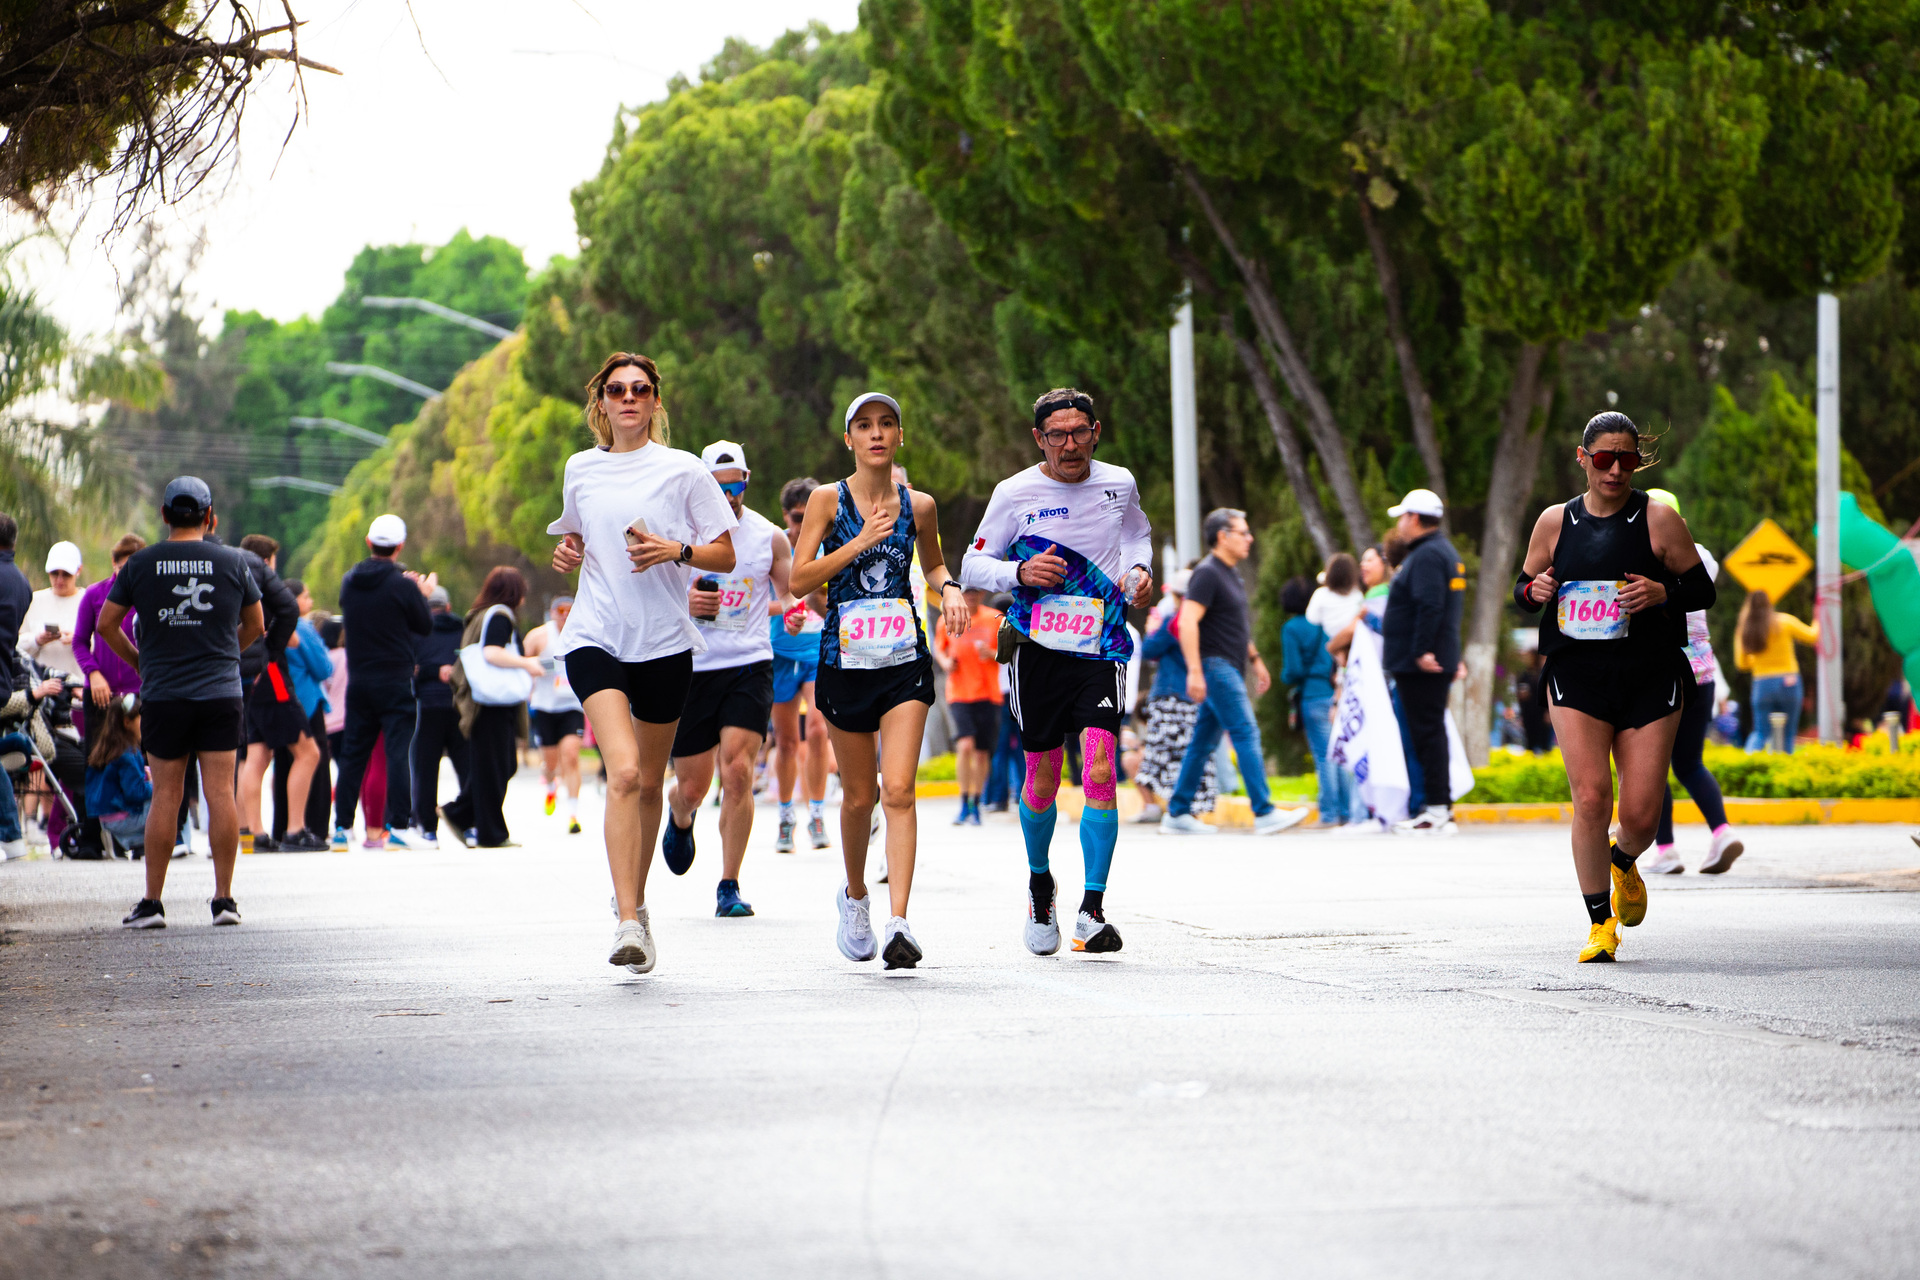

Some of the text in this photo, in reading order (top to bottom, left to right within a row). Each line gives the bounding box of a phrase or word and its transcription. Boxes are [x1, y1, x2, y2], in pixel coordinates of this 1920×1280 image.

[1038, 507, 1069, 518] ATOTO
[156, 560, 213, 576] FINISHER
[1569, 600, 1621, 621] 1604
[849, 615, 906, 641] 3179
[1040, 611, 1095, 636] 3842
